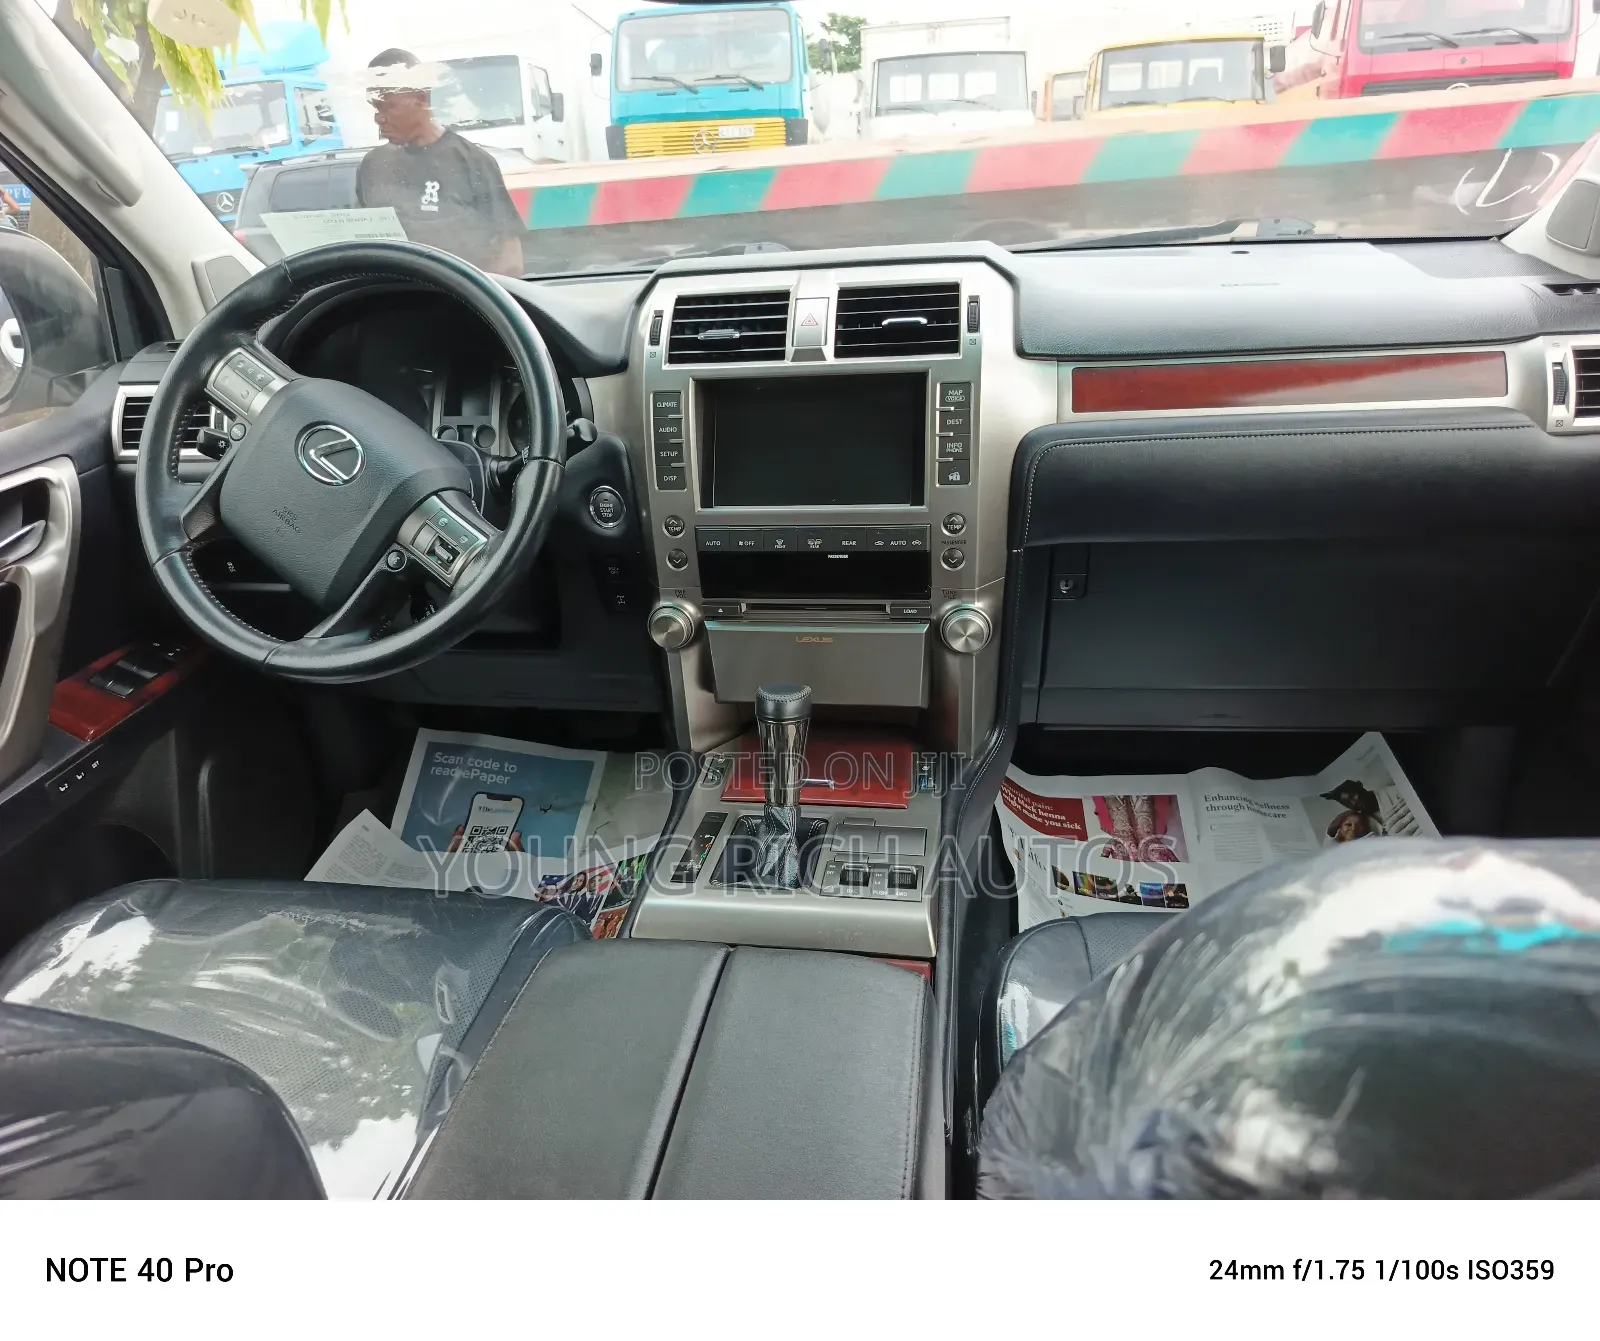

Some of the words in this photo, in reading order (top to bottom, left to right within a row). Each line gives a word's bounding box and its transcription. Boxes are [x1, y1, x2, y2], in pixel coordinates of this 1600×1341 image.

[272, 509, 301, 534] AIRBAG
[433, 752, 463, 765] Scan
[467, 756, 500, 771] code
[503, 761, 518, 774] to
[430, 765, 460, 777] read
[462, 768, 512, 785] ePaper
[1000, 784, 1018, 802] Why
[1017, 796, 1038, 813] black
[1038, 808, 1066, 820] henna
[1002, 792, 1022, 811] might
[1022, 806, 1043, 823] make
[1044, 819, 1061, 827] you
[1062, 820, 1082, 830] sick
[1032, 801, 1054, 811] pain:
[1203, 793, 1254, 806] Enhancing
[1253, 801, 1290, 810] wellness
[1205, 803, 1246, 812] through
